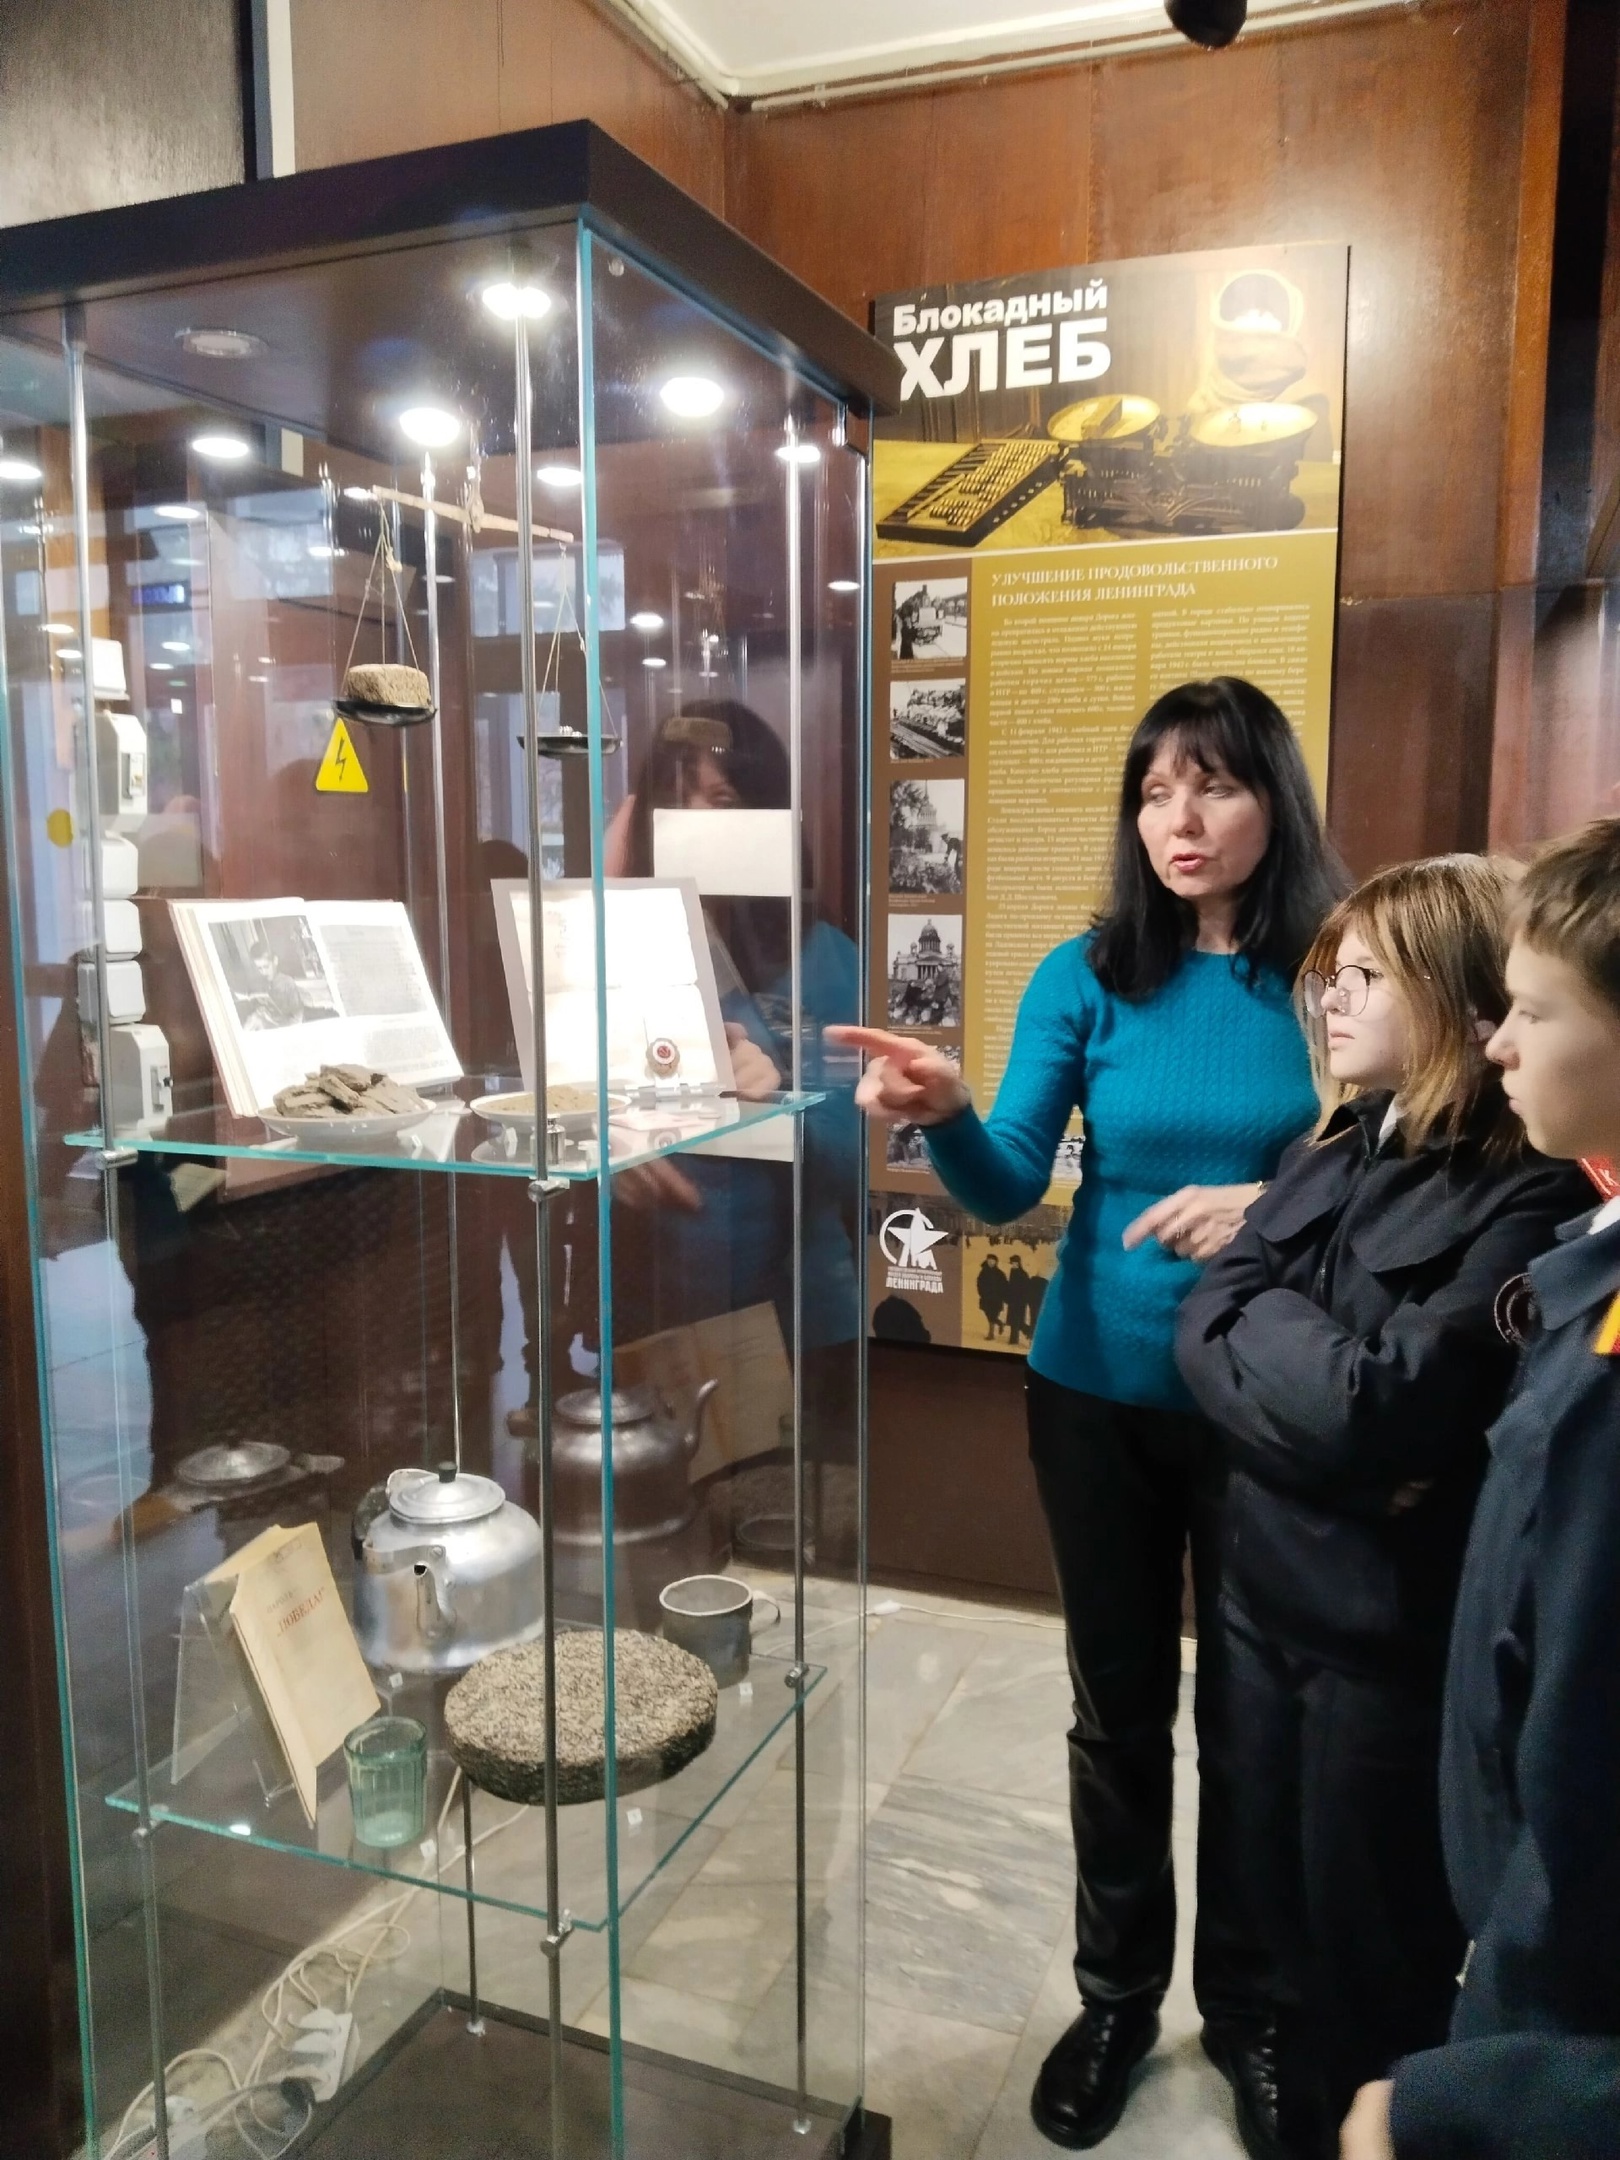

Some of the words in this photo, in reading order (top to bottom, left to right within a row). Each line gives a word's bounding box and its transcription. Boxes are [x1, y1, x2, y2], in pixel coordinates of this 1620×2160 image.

[893, 279, 1108, 336] Блокадный
[893, 317, 1111, 401] ХЛЕБ
[992, 569, 1085, 587] УЛУЧШЕНИЕ
[1088, 556, 1278, 580] ПРОДОВОЛЬСТВЕННОГО
[992, 588, 1092, 607] ПОЛОЖЕНИЯ
[1095, 582, 1196, 601] ЛЕНИНГРАДА
[886, 1276, 943, 1293] ЛЕНИНГРАДА
